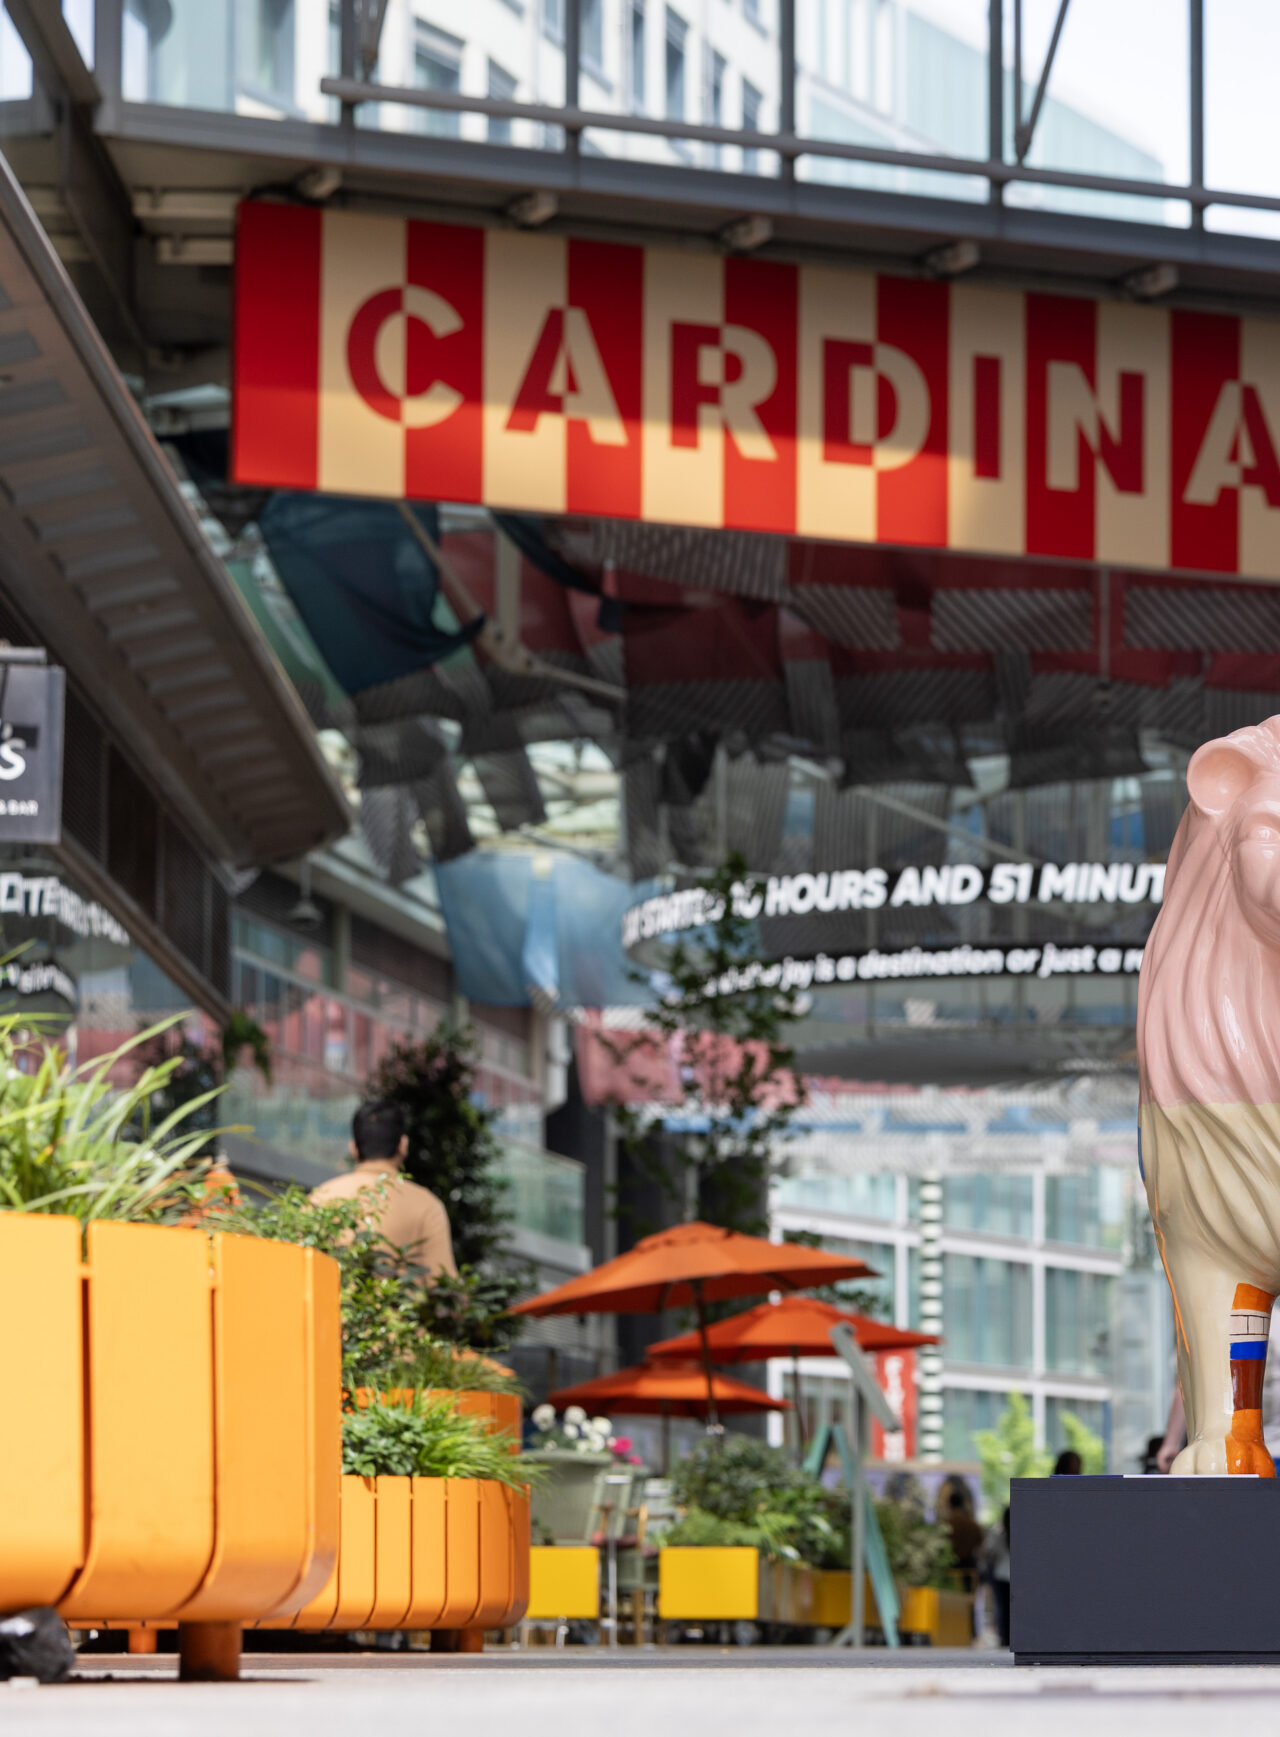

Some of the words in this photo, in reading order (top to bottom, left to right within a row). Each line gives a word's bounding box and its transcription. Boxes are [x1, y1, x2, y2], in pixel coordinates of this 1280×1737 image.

[764, 867, 889, 917] HOURS
[889, 864, 984, 907] AND
[987, 863, 1034, 903] 51
[857, 943, 1004, 980] destination
[1005, 948, 1042, 974] or
[1036, 942, 1097, 979] just
